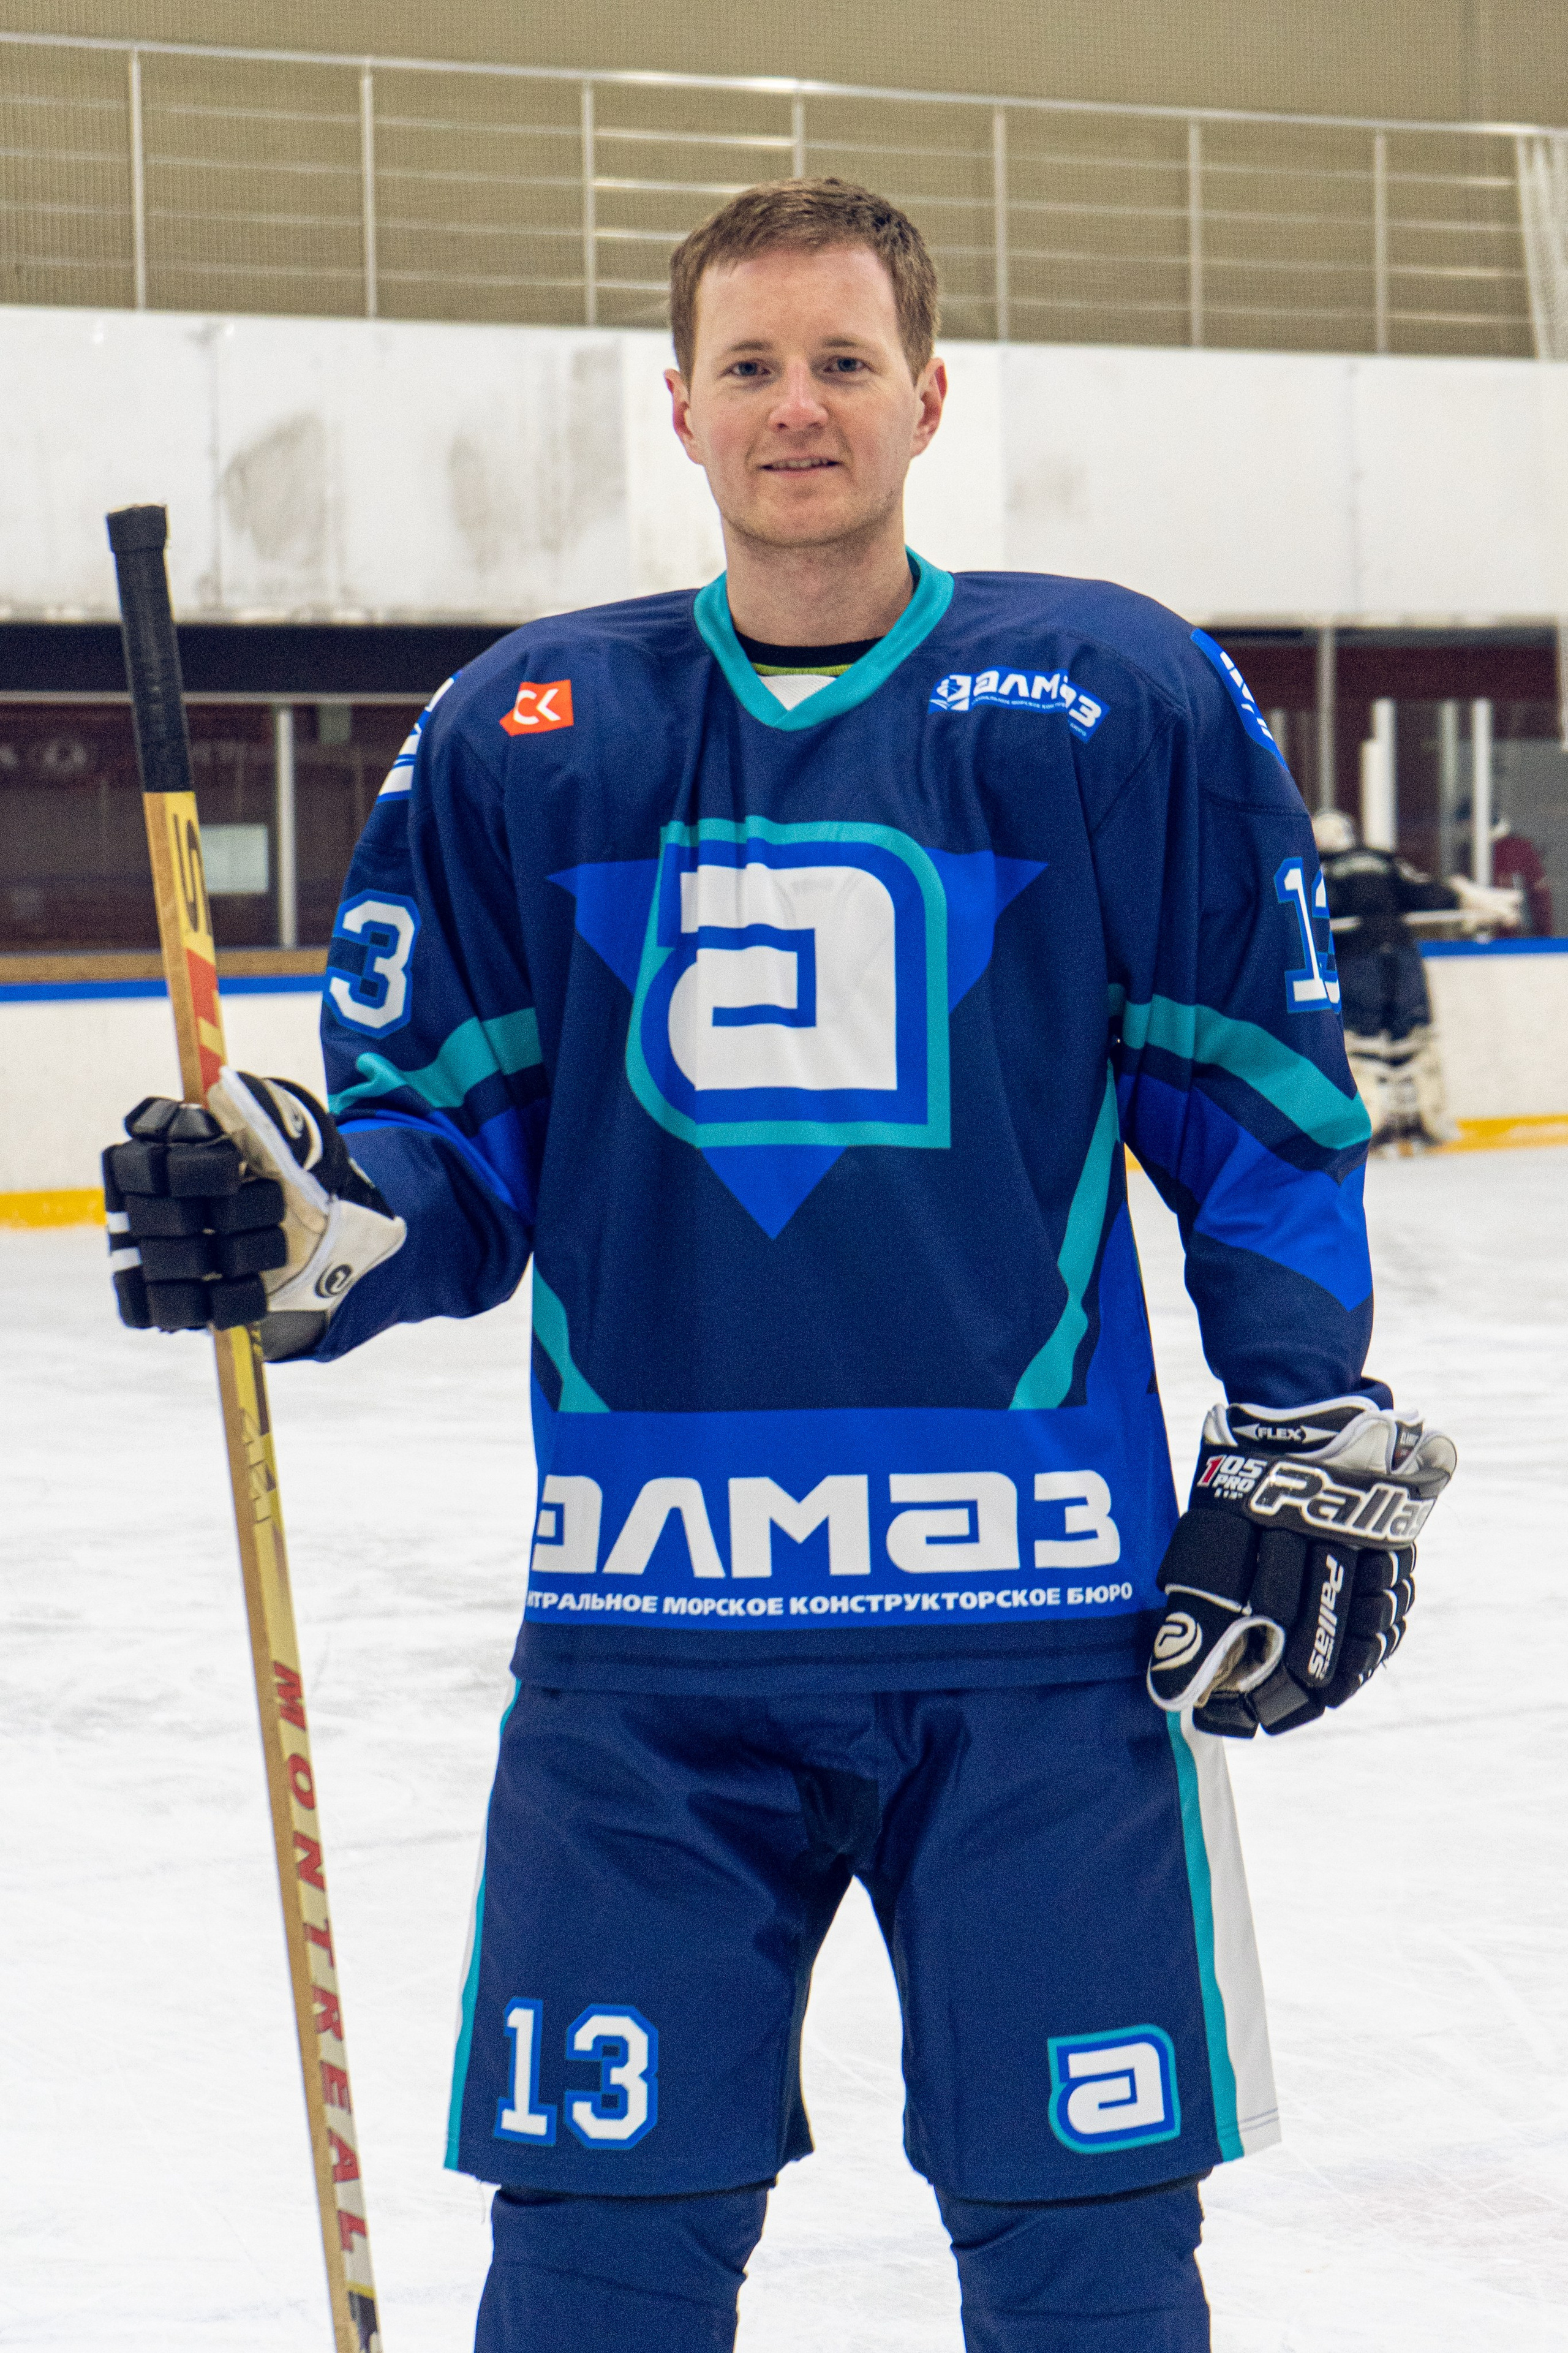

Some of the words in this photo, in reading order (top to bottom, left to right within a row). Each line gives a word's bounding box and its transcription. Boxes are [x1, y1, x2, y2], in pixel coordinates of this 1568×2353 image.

[1258, 1427, 1302, 1441] FLEX
[1197, 1455, 1268, 1487] 105
[1213, 1476, 1256, 1492] PRO
[663, 1596, 783, 1616] МОРСКОЕ
[790, 1588, 1060, 1614] КОНСТРУКТОРСКОЕ
[1067, 1582, 1133, 1605] БЮРО
[1308, 1554, 1344, 1679] Pallas
[273, 1660, 367, 2253] MONTREAL
[494, 1998, 658, 2149] 13
